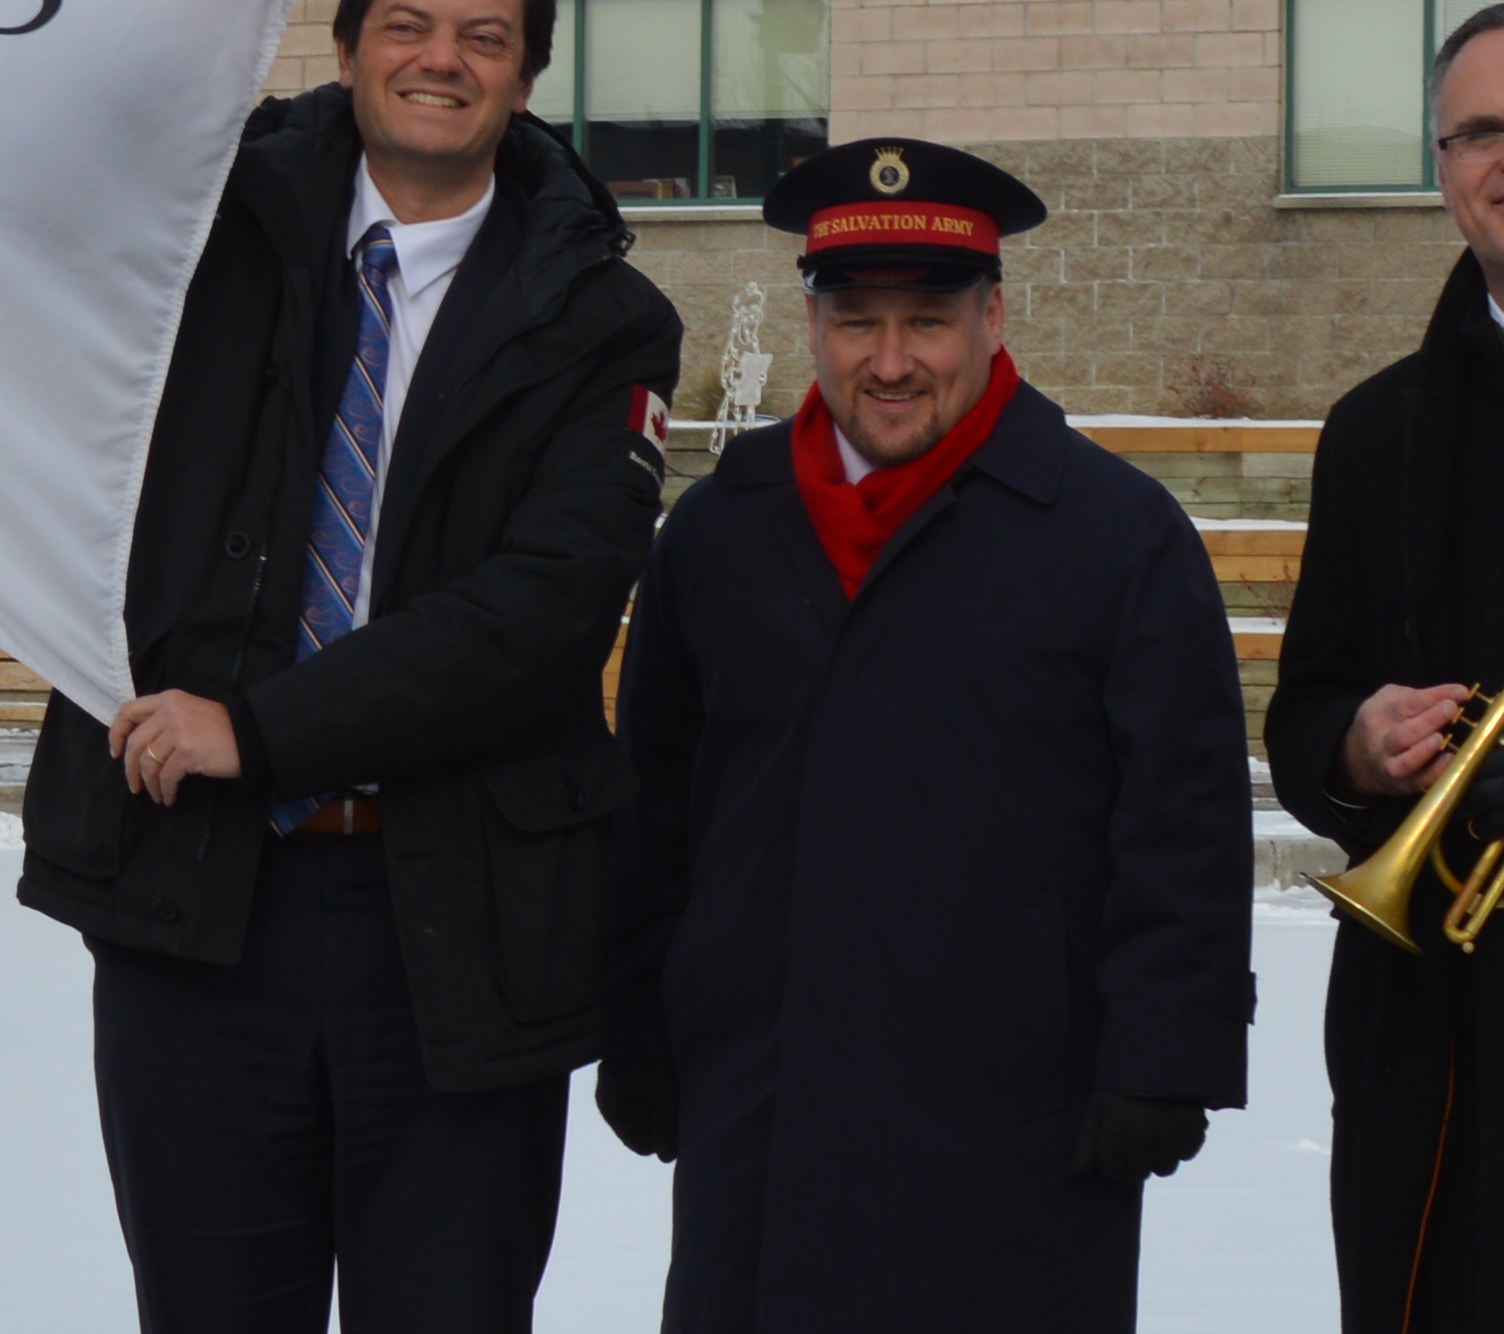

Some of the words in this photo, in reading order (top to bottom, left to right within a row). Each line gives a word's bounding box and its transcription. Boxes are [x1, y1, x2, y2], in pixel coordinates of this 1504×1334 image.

[813, 220, 830, 239] THE
[831, 214, 927, 234] SALVATION
[931, 216, 974, 237] ARMY
